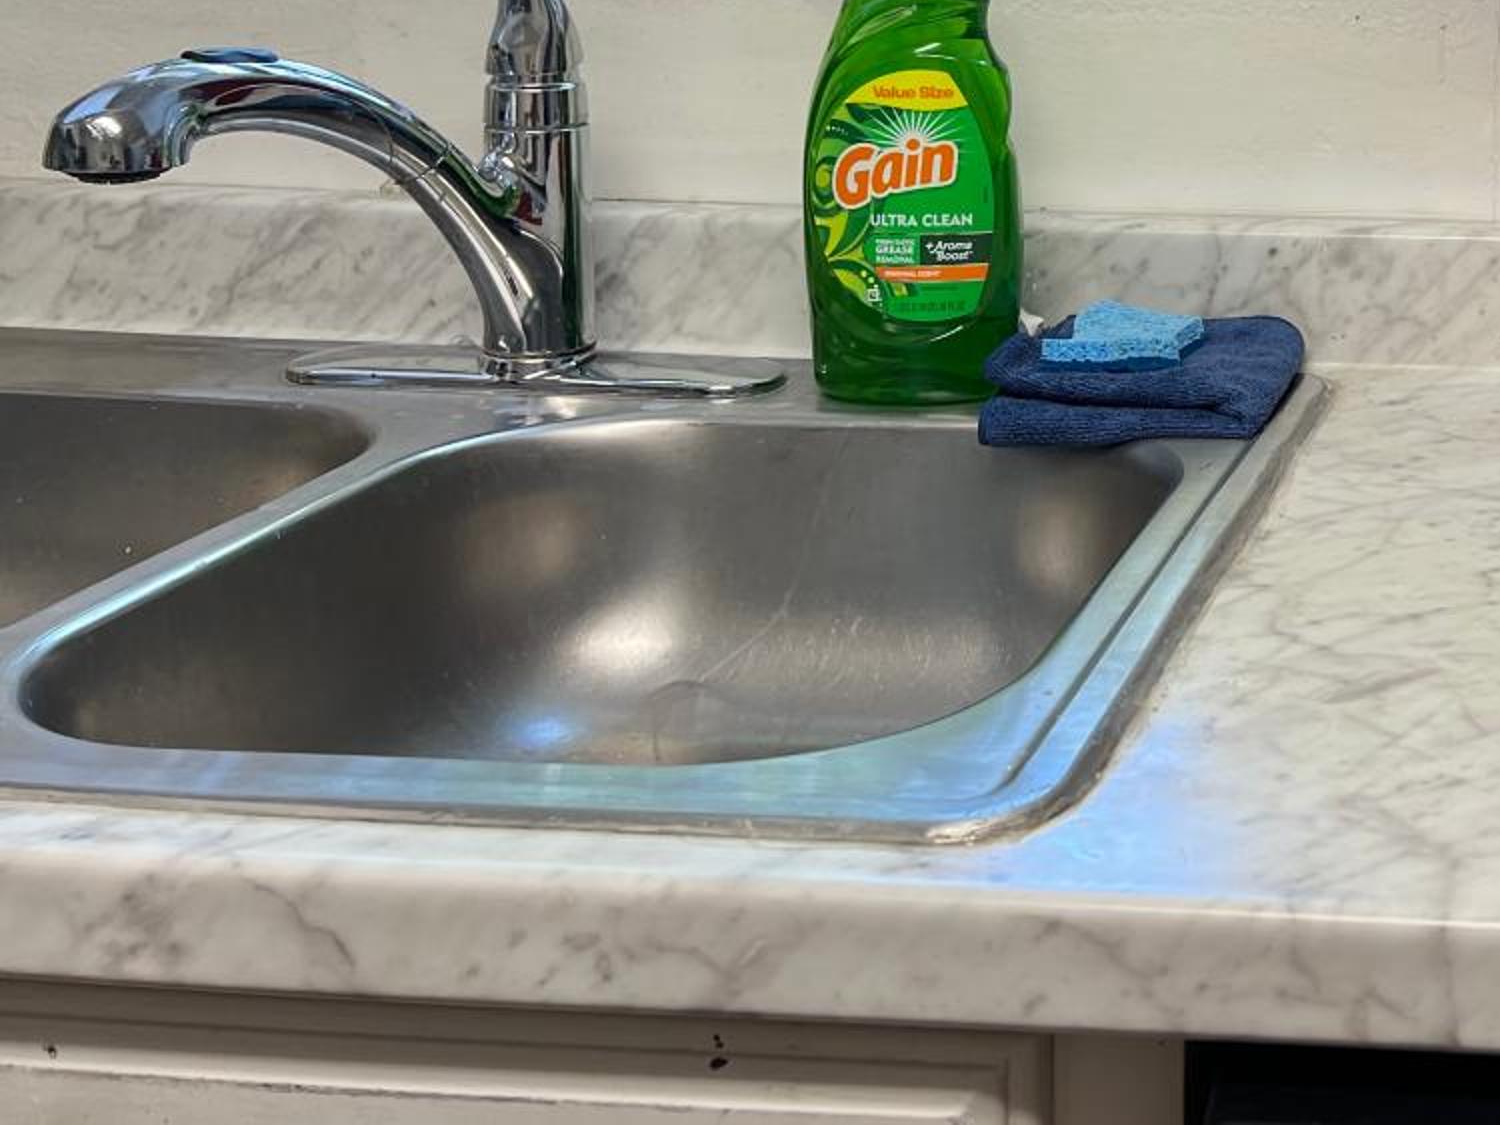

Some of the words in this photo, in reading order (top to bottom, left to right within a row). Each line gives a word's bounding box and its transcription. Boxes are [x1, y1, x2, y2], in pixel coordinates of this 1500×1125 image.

[873, 84, 916, 99] Value
[919, 86, 954, 100] Size
[834, 138, 957, 208] Gain
[870, 213, 918, 227] ULTRA
[921, 213, 973, 227] CLEAN
[875, 244, 914, 254] GREASE
